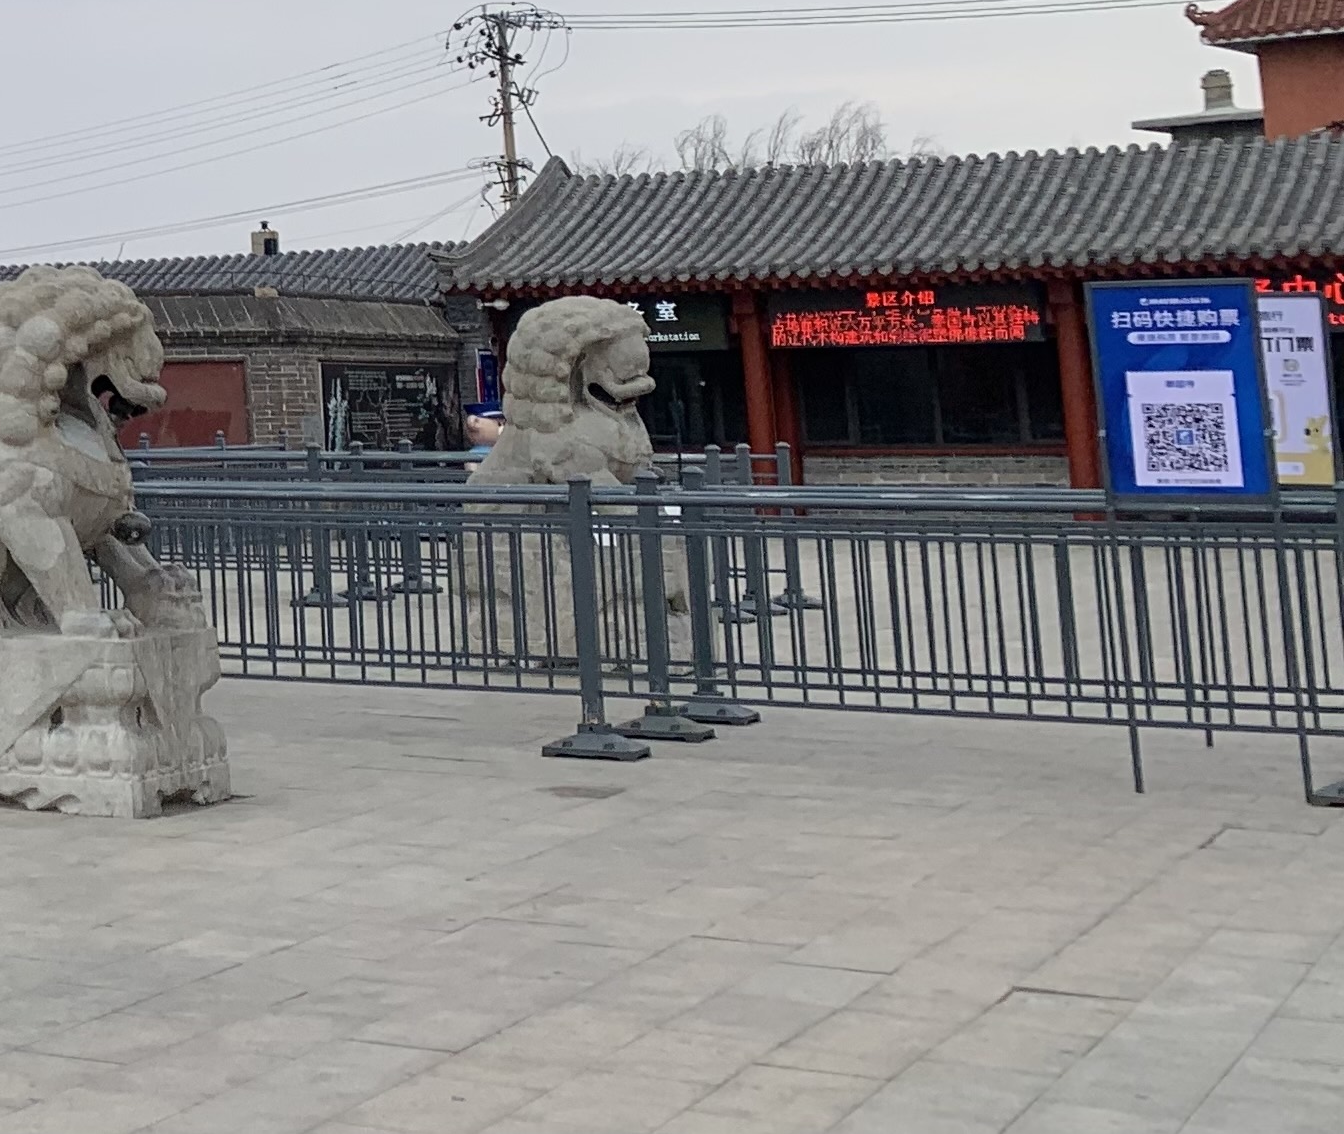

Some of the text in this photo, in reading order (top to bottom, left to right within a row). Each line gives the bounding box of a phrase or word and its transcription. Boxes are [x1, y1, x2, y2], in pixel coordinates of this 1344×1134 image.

[865, 290, 936, 308] 景区介绍
[1111, 309, 1240, 328] 扫码快捷购票
[645, 331, 701, 342] orkstation
